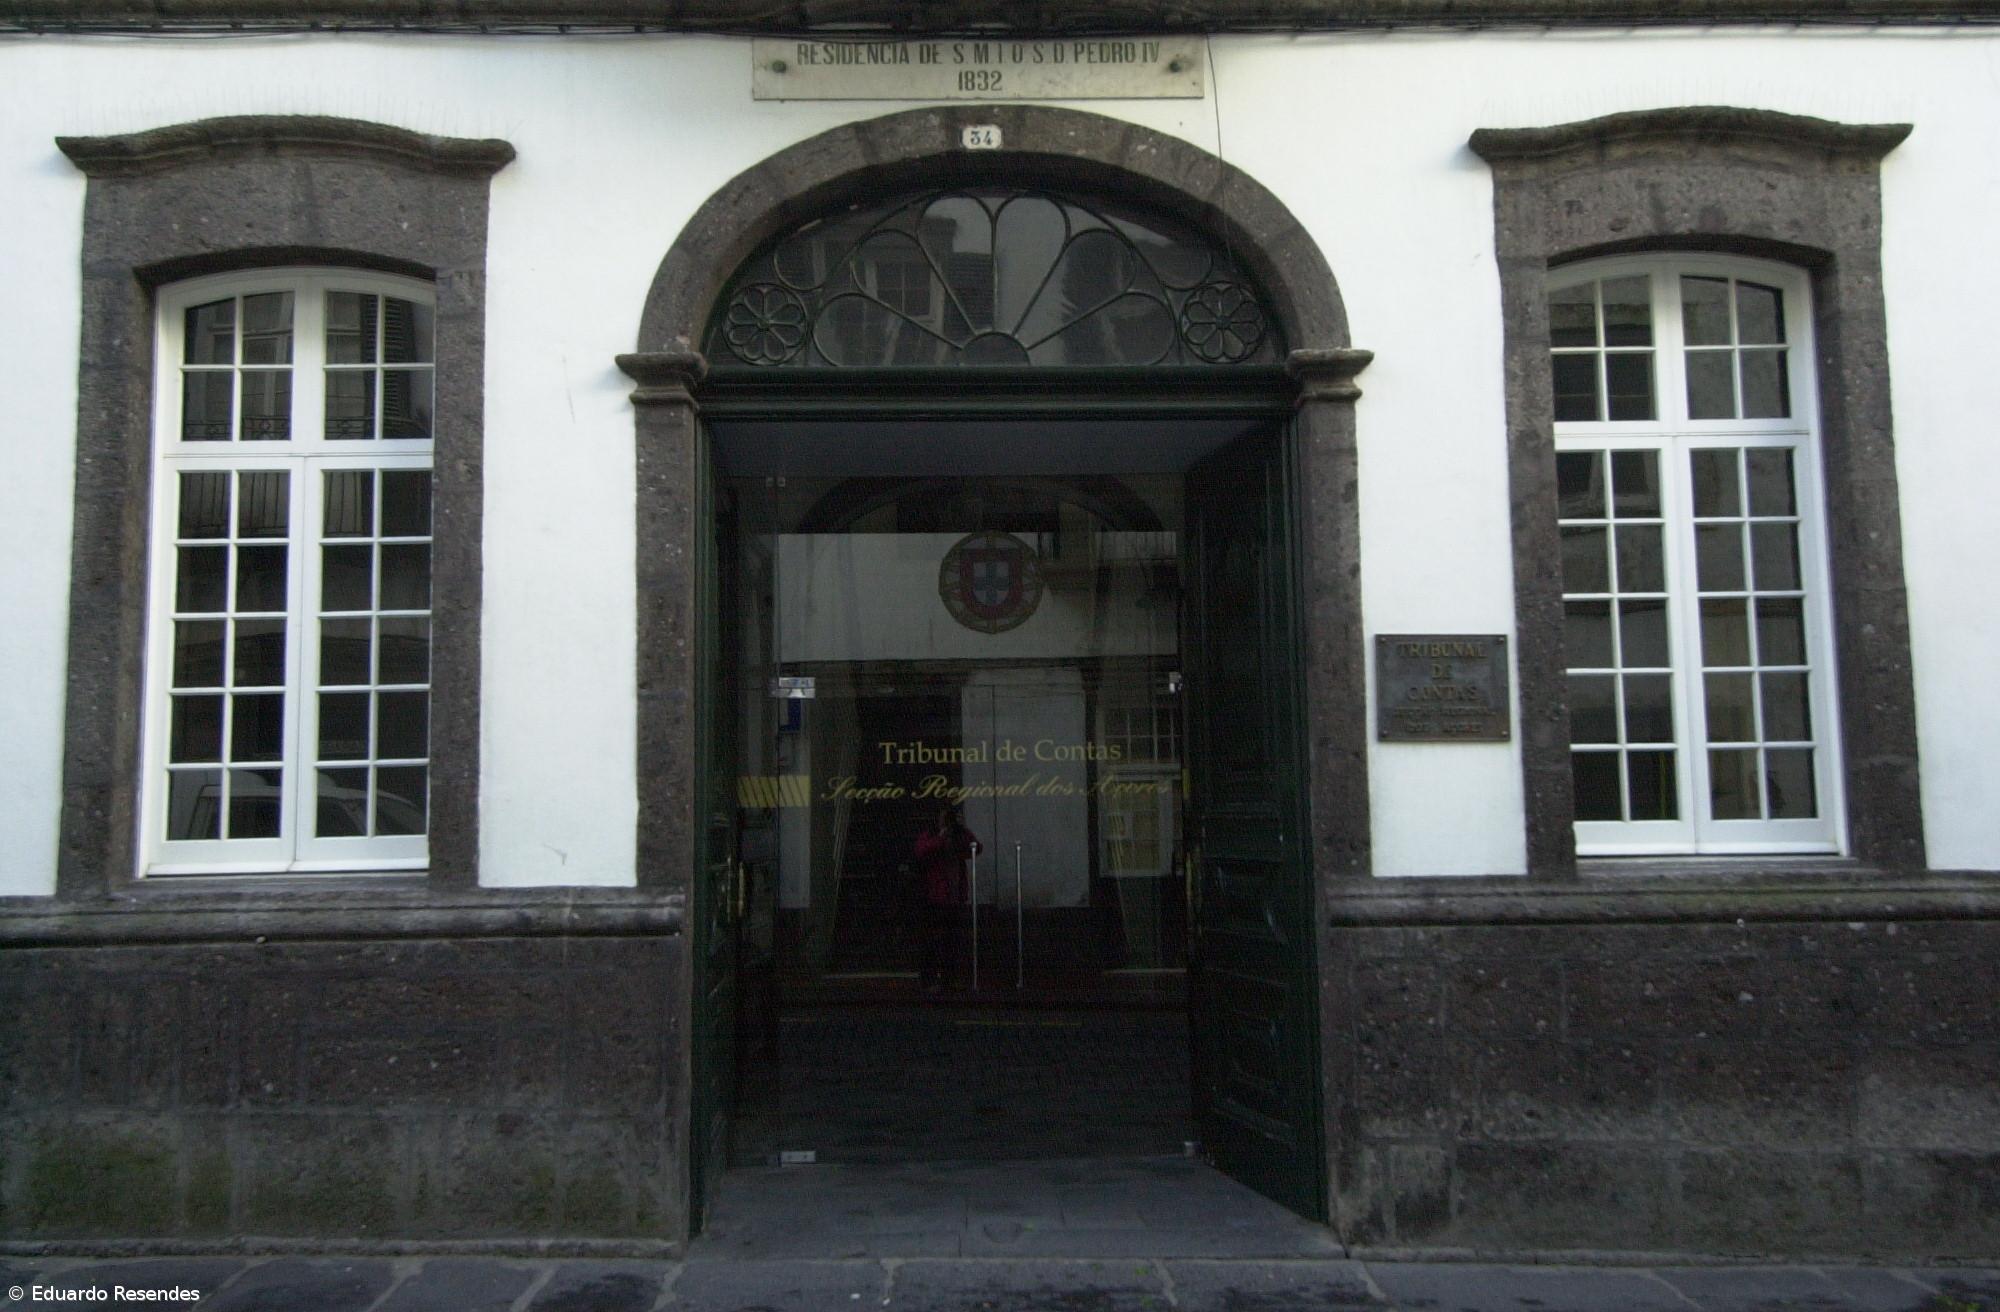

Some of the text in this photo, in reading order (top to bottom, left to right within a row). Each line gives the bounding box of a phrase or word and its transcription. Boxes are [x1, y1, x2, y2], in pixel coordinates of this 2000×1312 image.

[797, 43, 910, 64] RESIDENCIA
[919, 43, 943, 64] DE
[1073, 42, 1137, 64] PEDRO
[1141, 42, 1160, 64] IV
[957, 71, 1003, 92] 1832
[970, 130, 993, 146] 34
[1397, 642, 1487, 658] TRIBUNAL
[879, 738, 1122, 764] Tribunal de Contas
[911, 773, 1041, 806] Regional
[1036, 775, 1074, 797] dos
